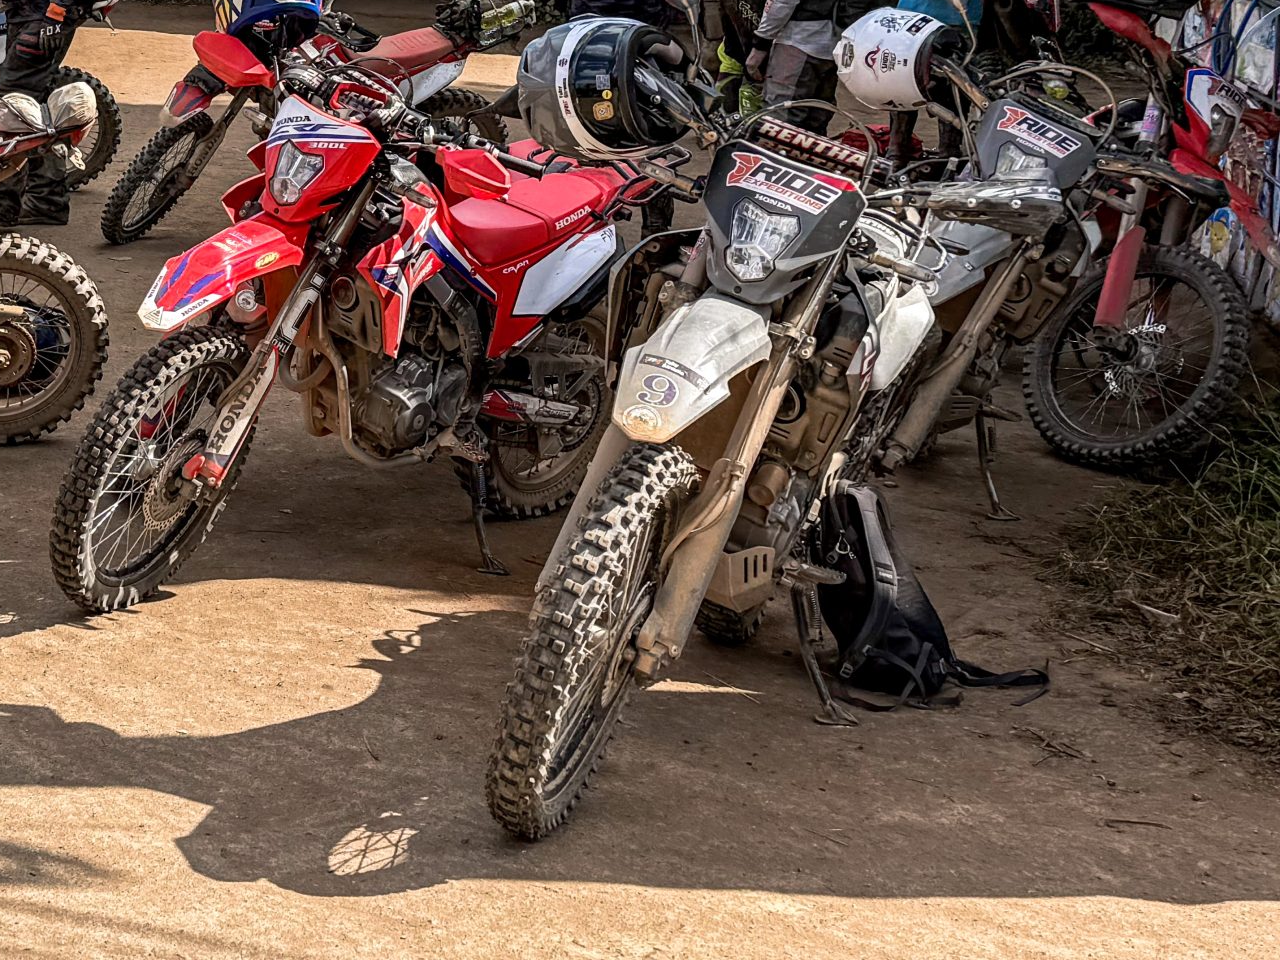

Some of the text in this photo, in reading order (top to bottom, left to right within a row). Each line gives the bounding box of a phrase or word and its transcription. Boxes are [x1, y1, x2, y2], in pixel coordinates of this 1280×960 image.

[40, 23, 62, 37] FOX
[276, 115, 312, 127] HONDA
[1016, 116, 1080, 153] RIDE
[307, 141, 349, 149] 300L
[757, 120, 868, 168] RENTHA
[1010, 125, 1068, 156] EXPEDITIONS
[1016, 137, 1046, 153] HONDA
[744, 175, 824, 211] EXPEDITIONS
[749, 162, 839, 205] RIDE
[754, 193, 793, 212] HONDA
[554, 205, 592, 231] HONDA
[180, 297, 210, 317] HONDA
[637, 374, 679, 407] 9
[207, 366, 268, 453] HONDA
